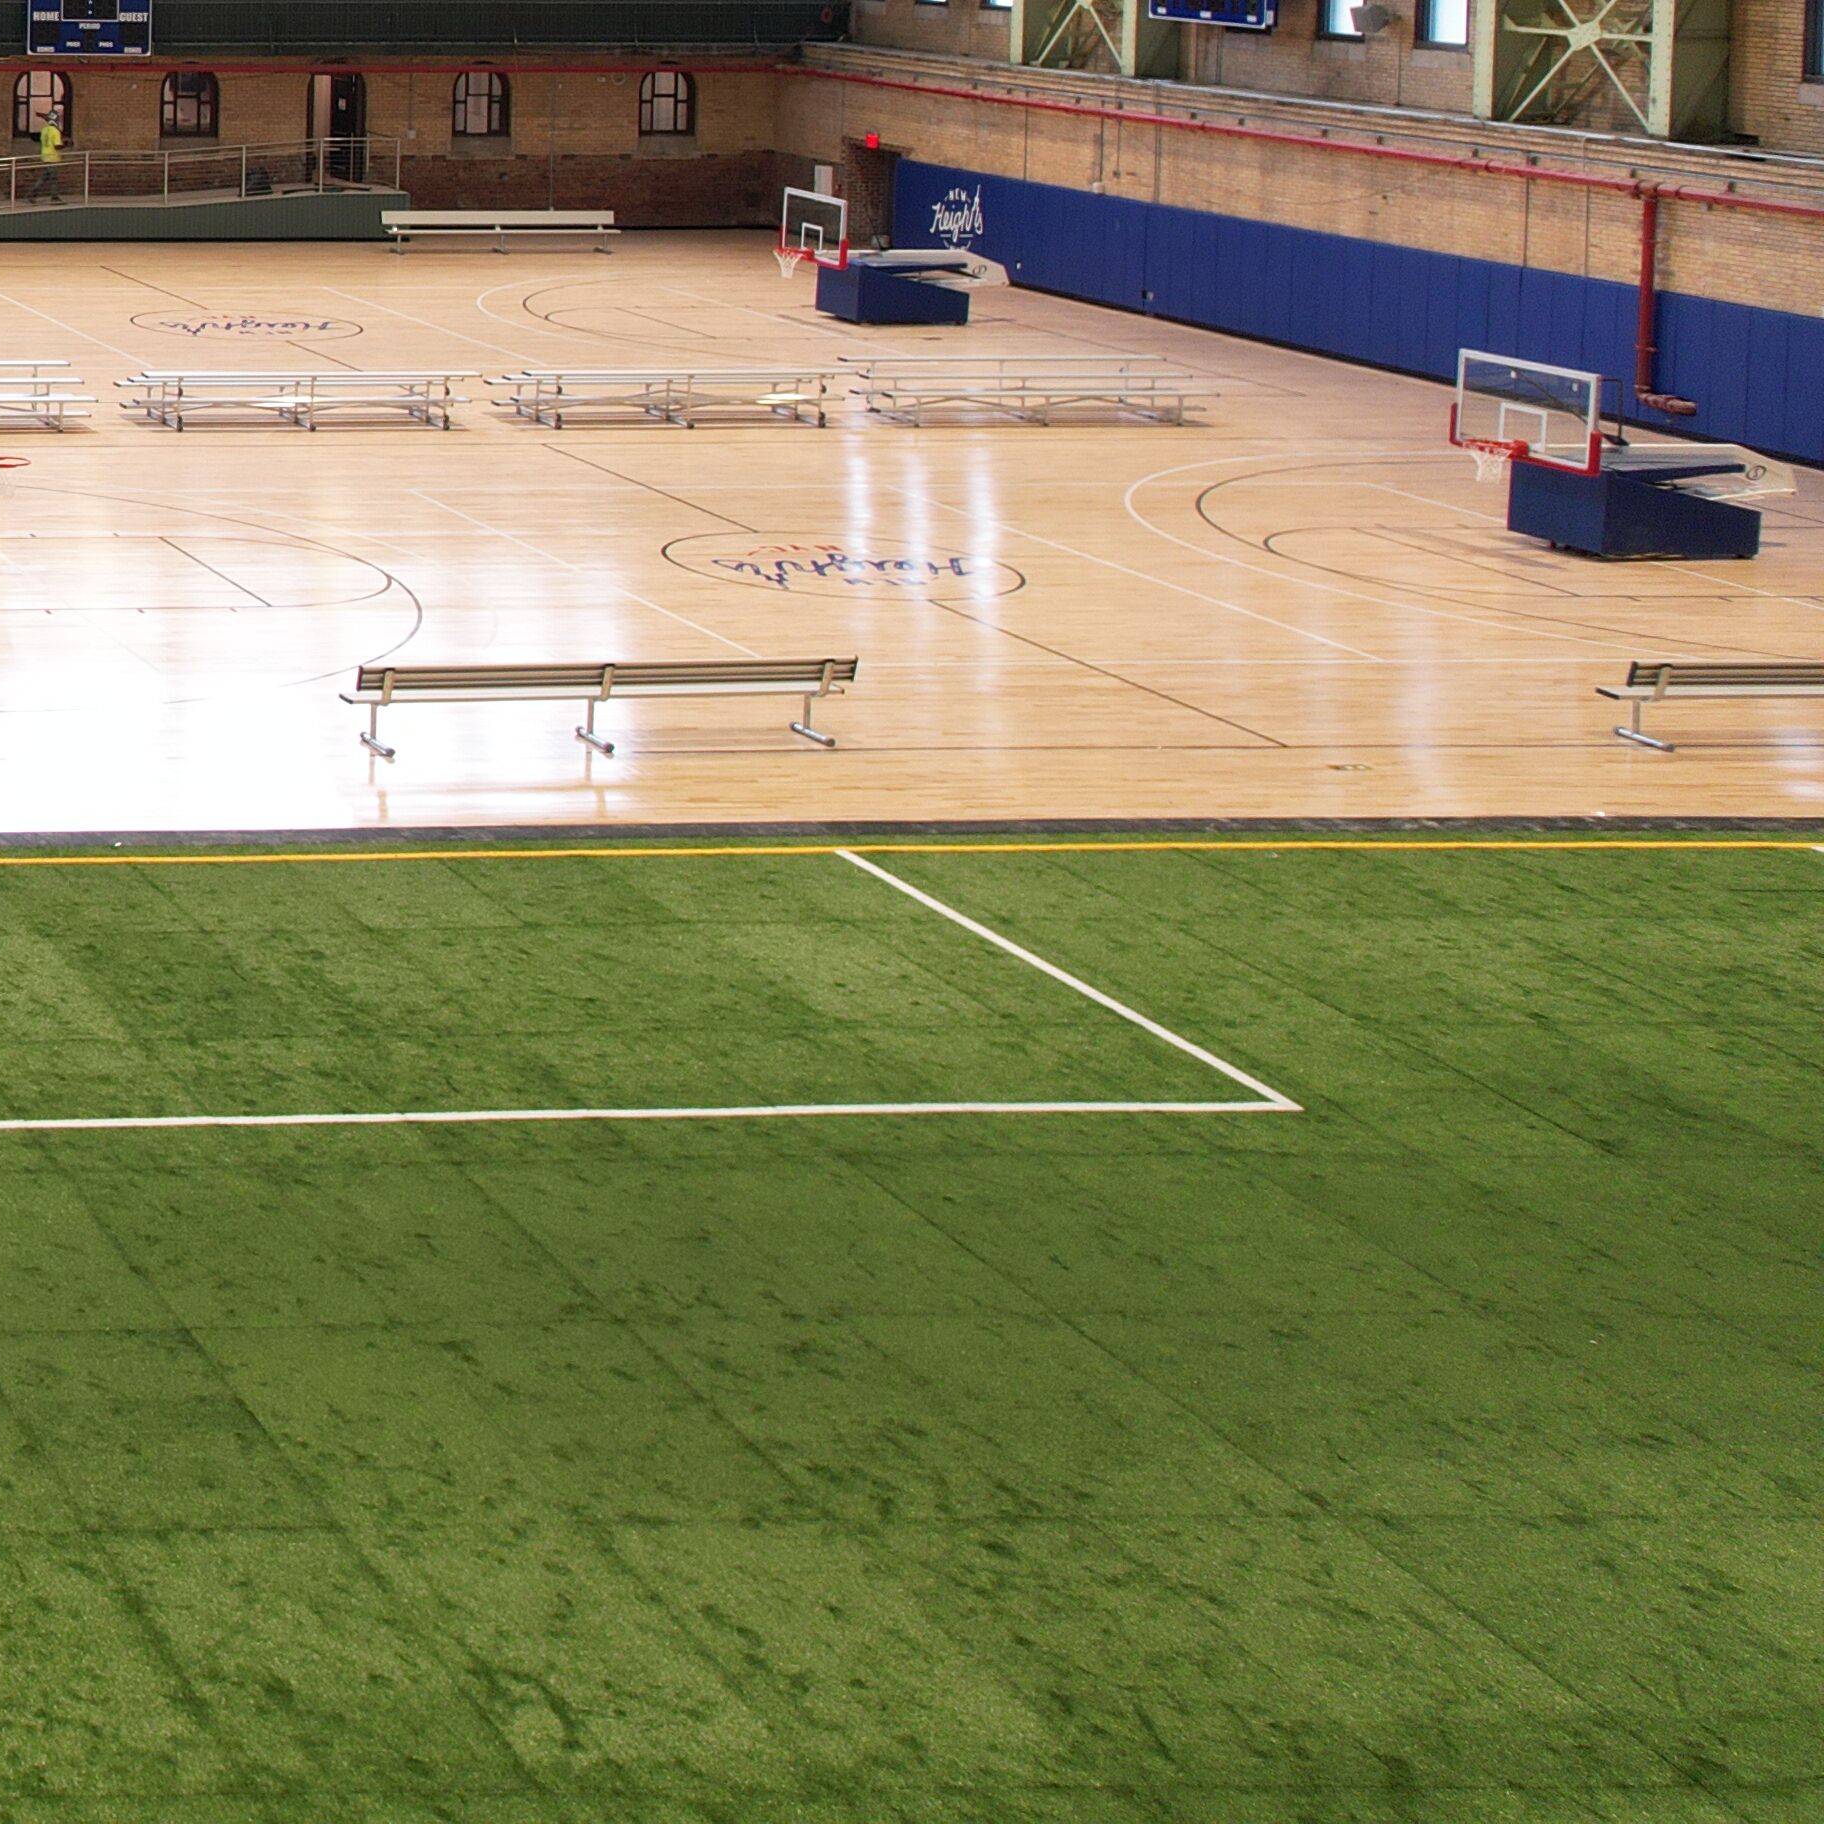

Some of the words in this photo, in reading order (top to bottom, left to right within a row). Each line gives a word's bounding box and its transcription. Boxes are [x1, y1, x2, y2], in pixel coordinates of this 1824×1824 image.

[33, 11, 60, 22] HOME
[119, 12, 149, 23] GUEST
[949, 187, 967, 202] NEW
[929, 184, 983, 243] Heights
